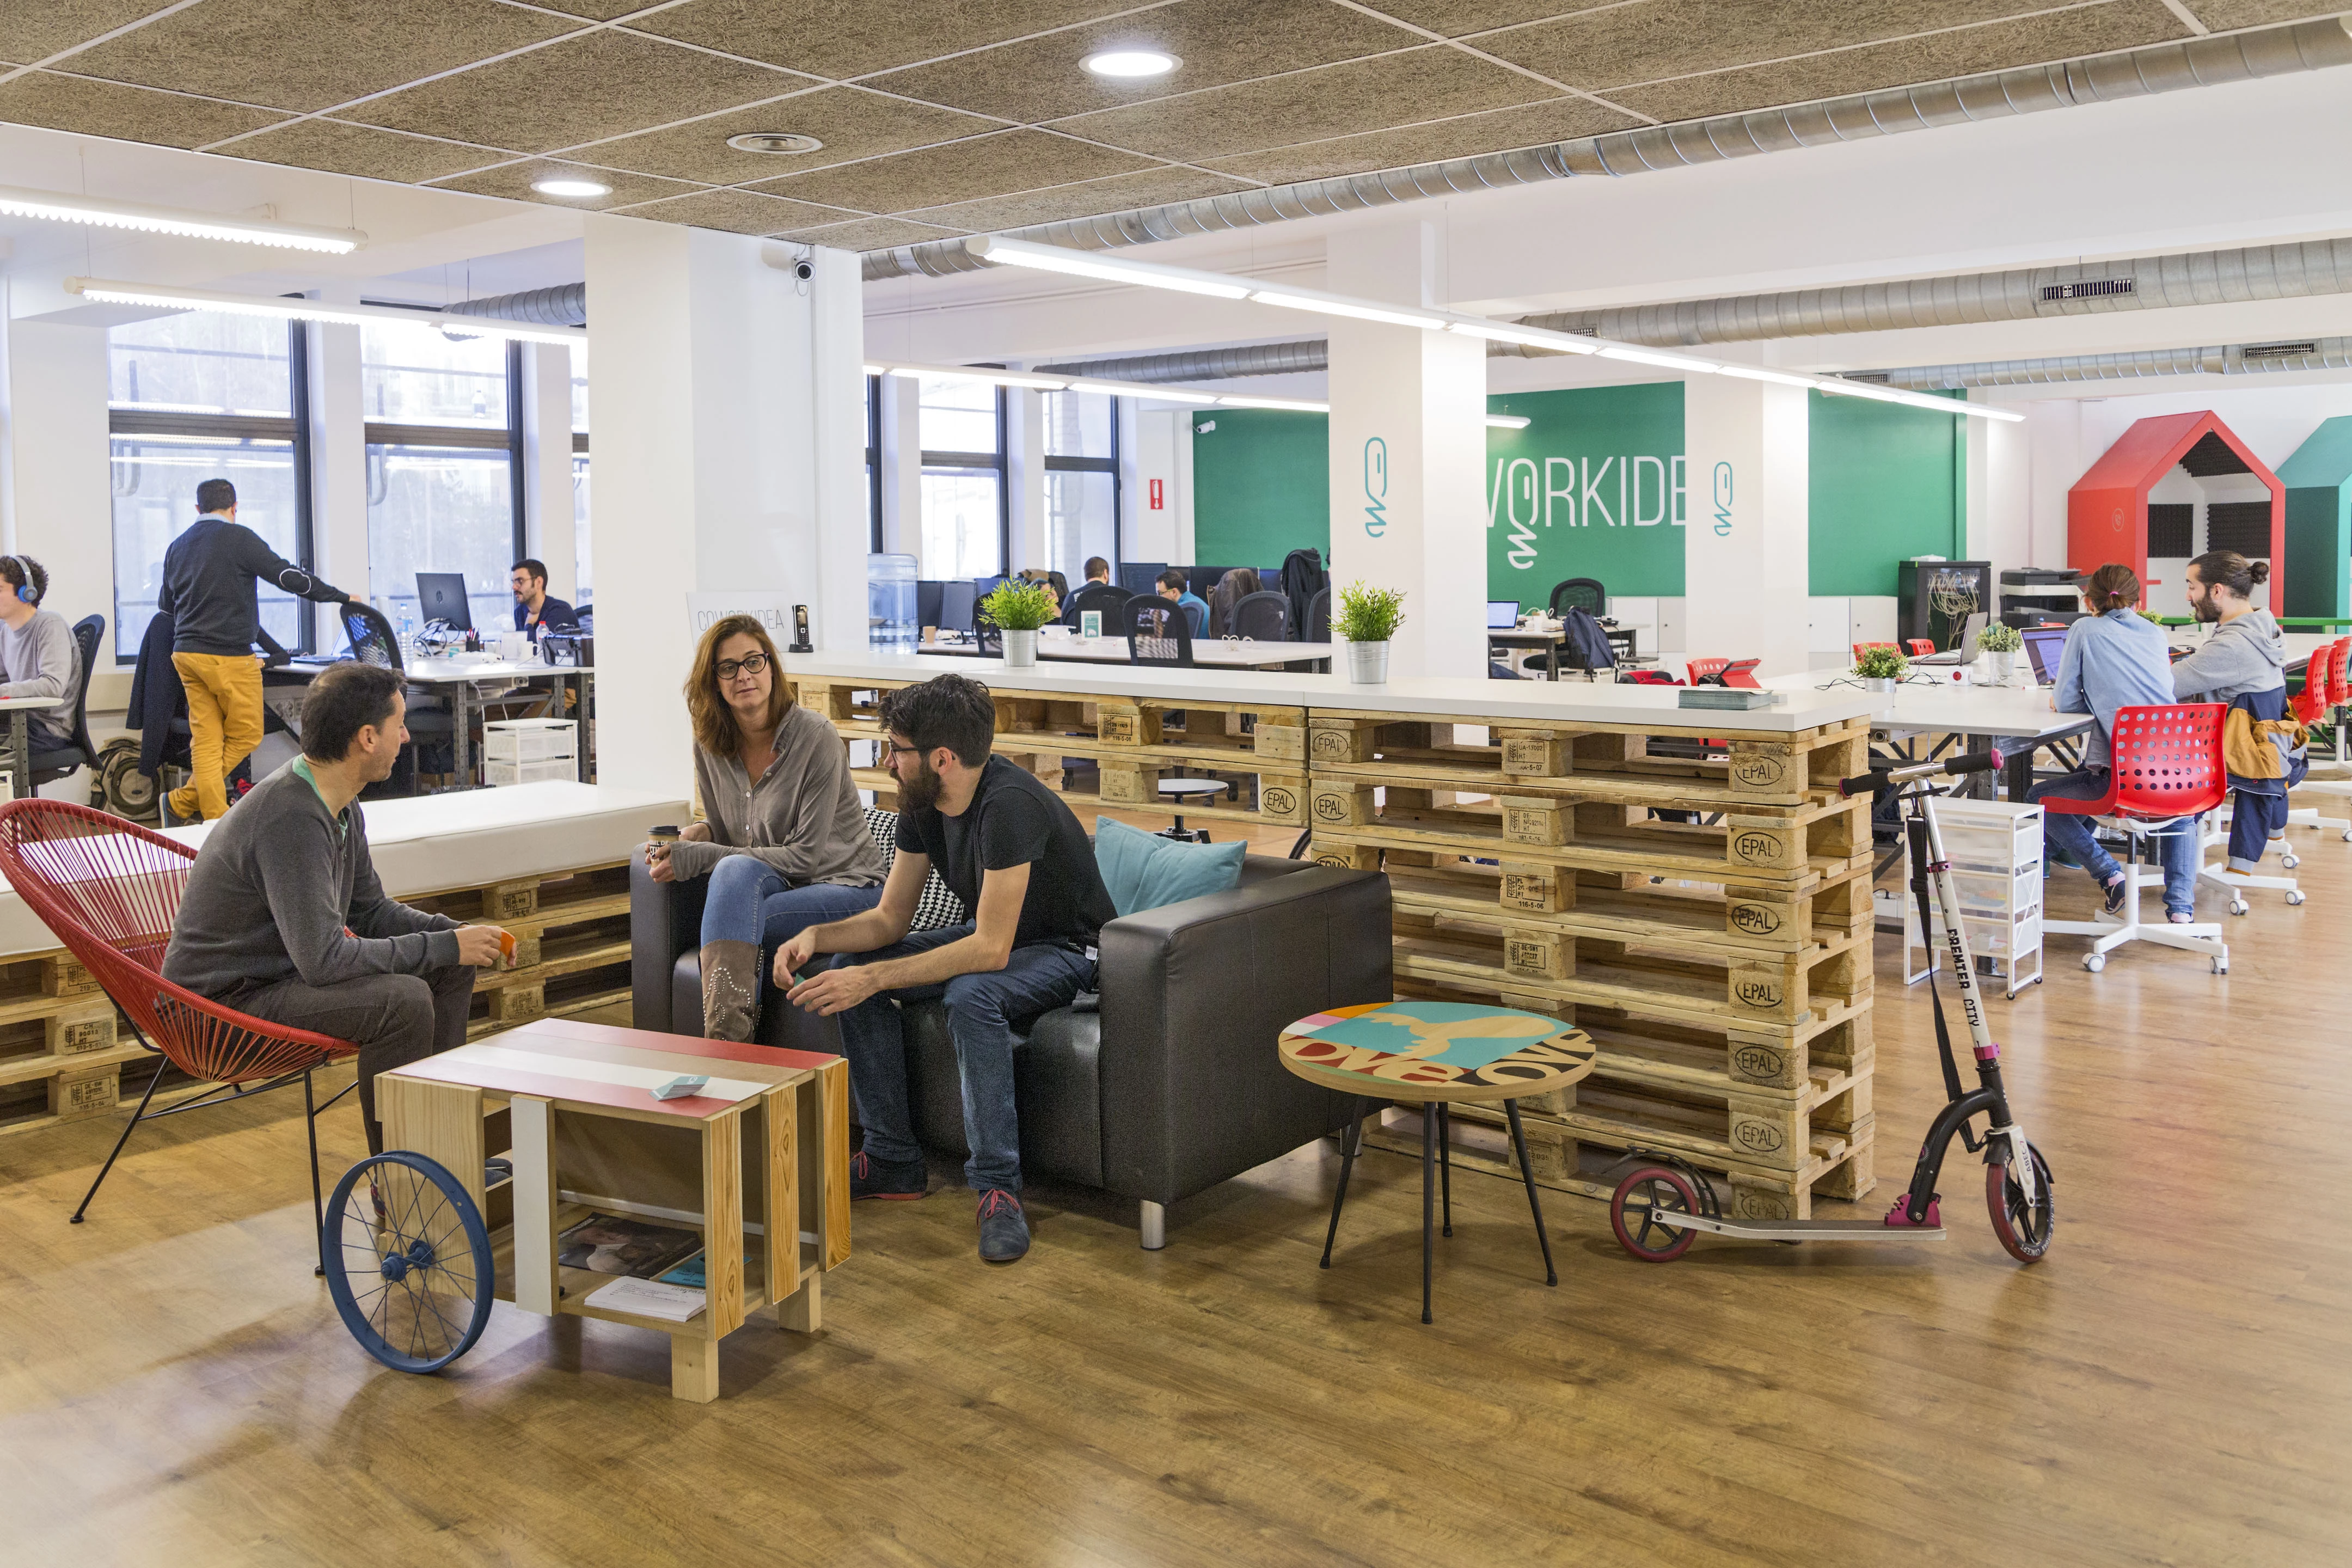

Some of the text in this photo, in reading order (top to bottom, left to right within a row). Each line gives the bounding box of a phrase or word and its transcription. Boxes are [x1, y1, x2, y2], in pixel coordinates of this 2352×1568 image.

[1742, 763, 1774, 779] EPAL
[1267, 792, 1291, 810] EPAL
[1319, 799, 1344, 815] EPAL
[1742, 838, 1774, 857] EPAL
[1518, 901, 1544, 909] 116-5-06
[1739, 908, 1772, 930] EPAL
[1743, 982, 1775, 1003] EPAL
[1963, 998, 1980, 1027] CITY
[1742, 1052, 1775, 1074] EPAL
[1742, 1125, 1776, 1148] EPAL
[2019, 1140, 2031, 1172] ABEC-7
[2020, 1244, 2041, 1257] CONCEPT
